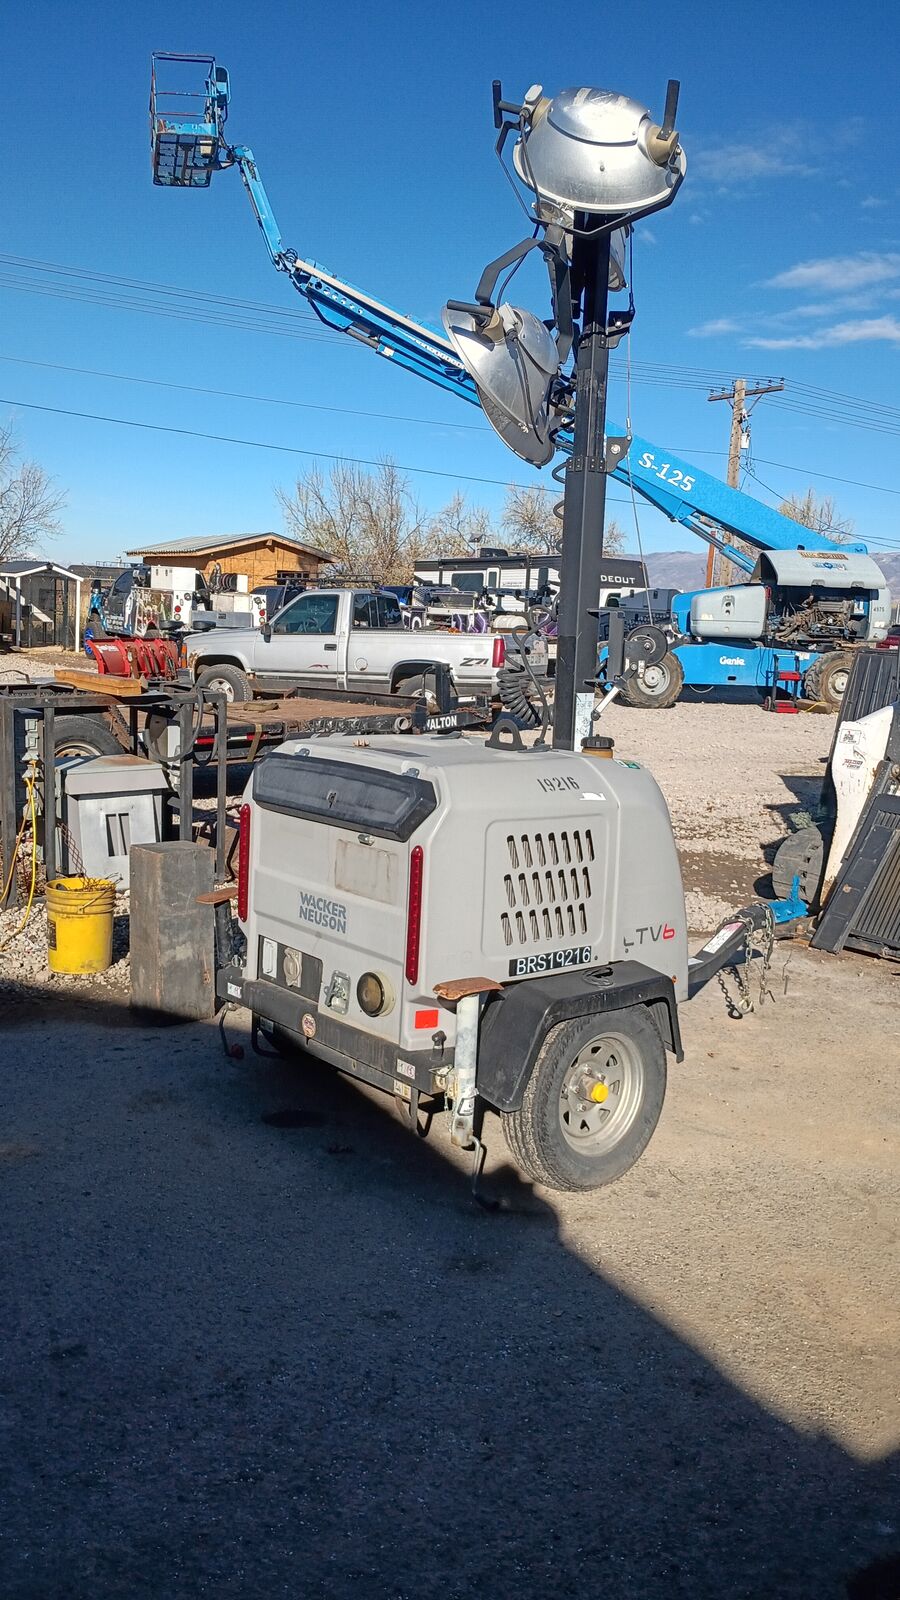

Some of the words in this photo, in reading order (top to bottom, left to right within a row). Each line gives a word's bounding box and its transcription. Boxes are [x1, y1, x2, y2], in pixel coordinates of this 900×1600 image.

[638, 452, 696, 492] S-125
[600, 574, 636, 584] DEOUT
[459, 657, 490, 667] Z71
[719, 656, 746, 666] Genie
[536, 776, 581, 793] 19216
[299, 891, 347, 920] WACKER
[299, 905, 347, 934] NEUSON
[515, 945, 592, 976] BRS19216
